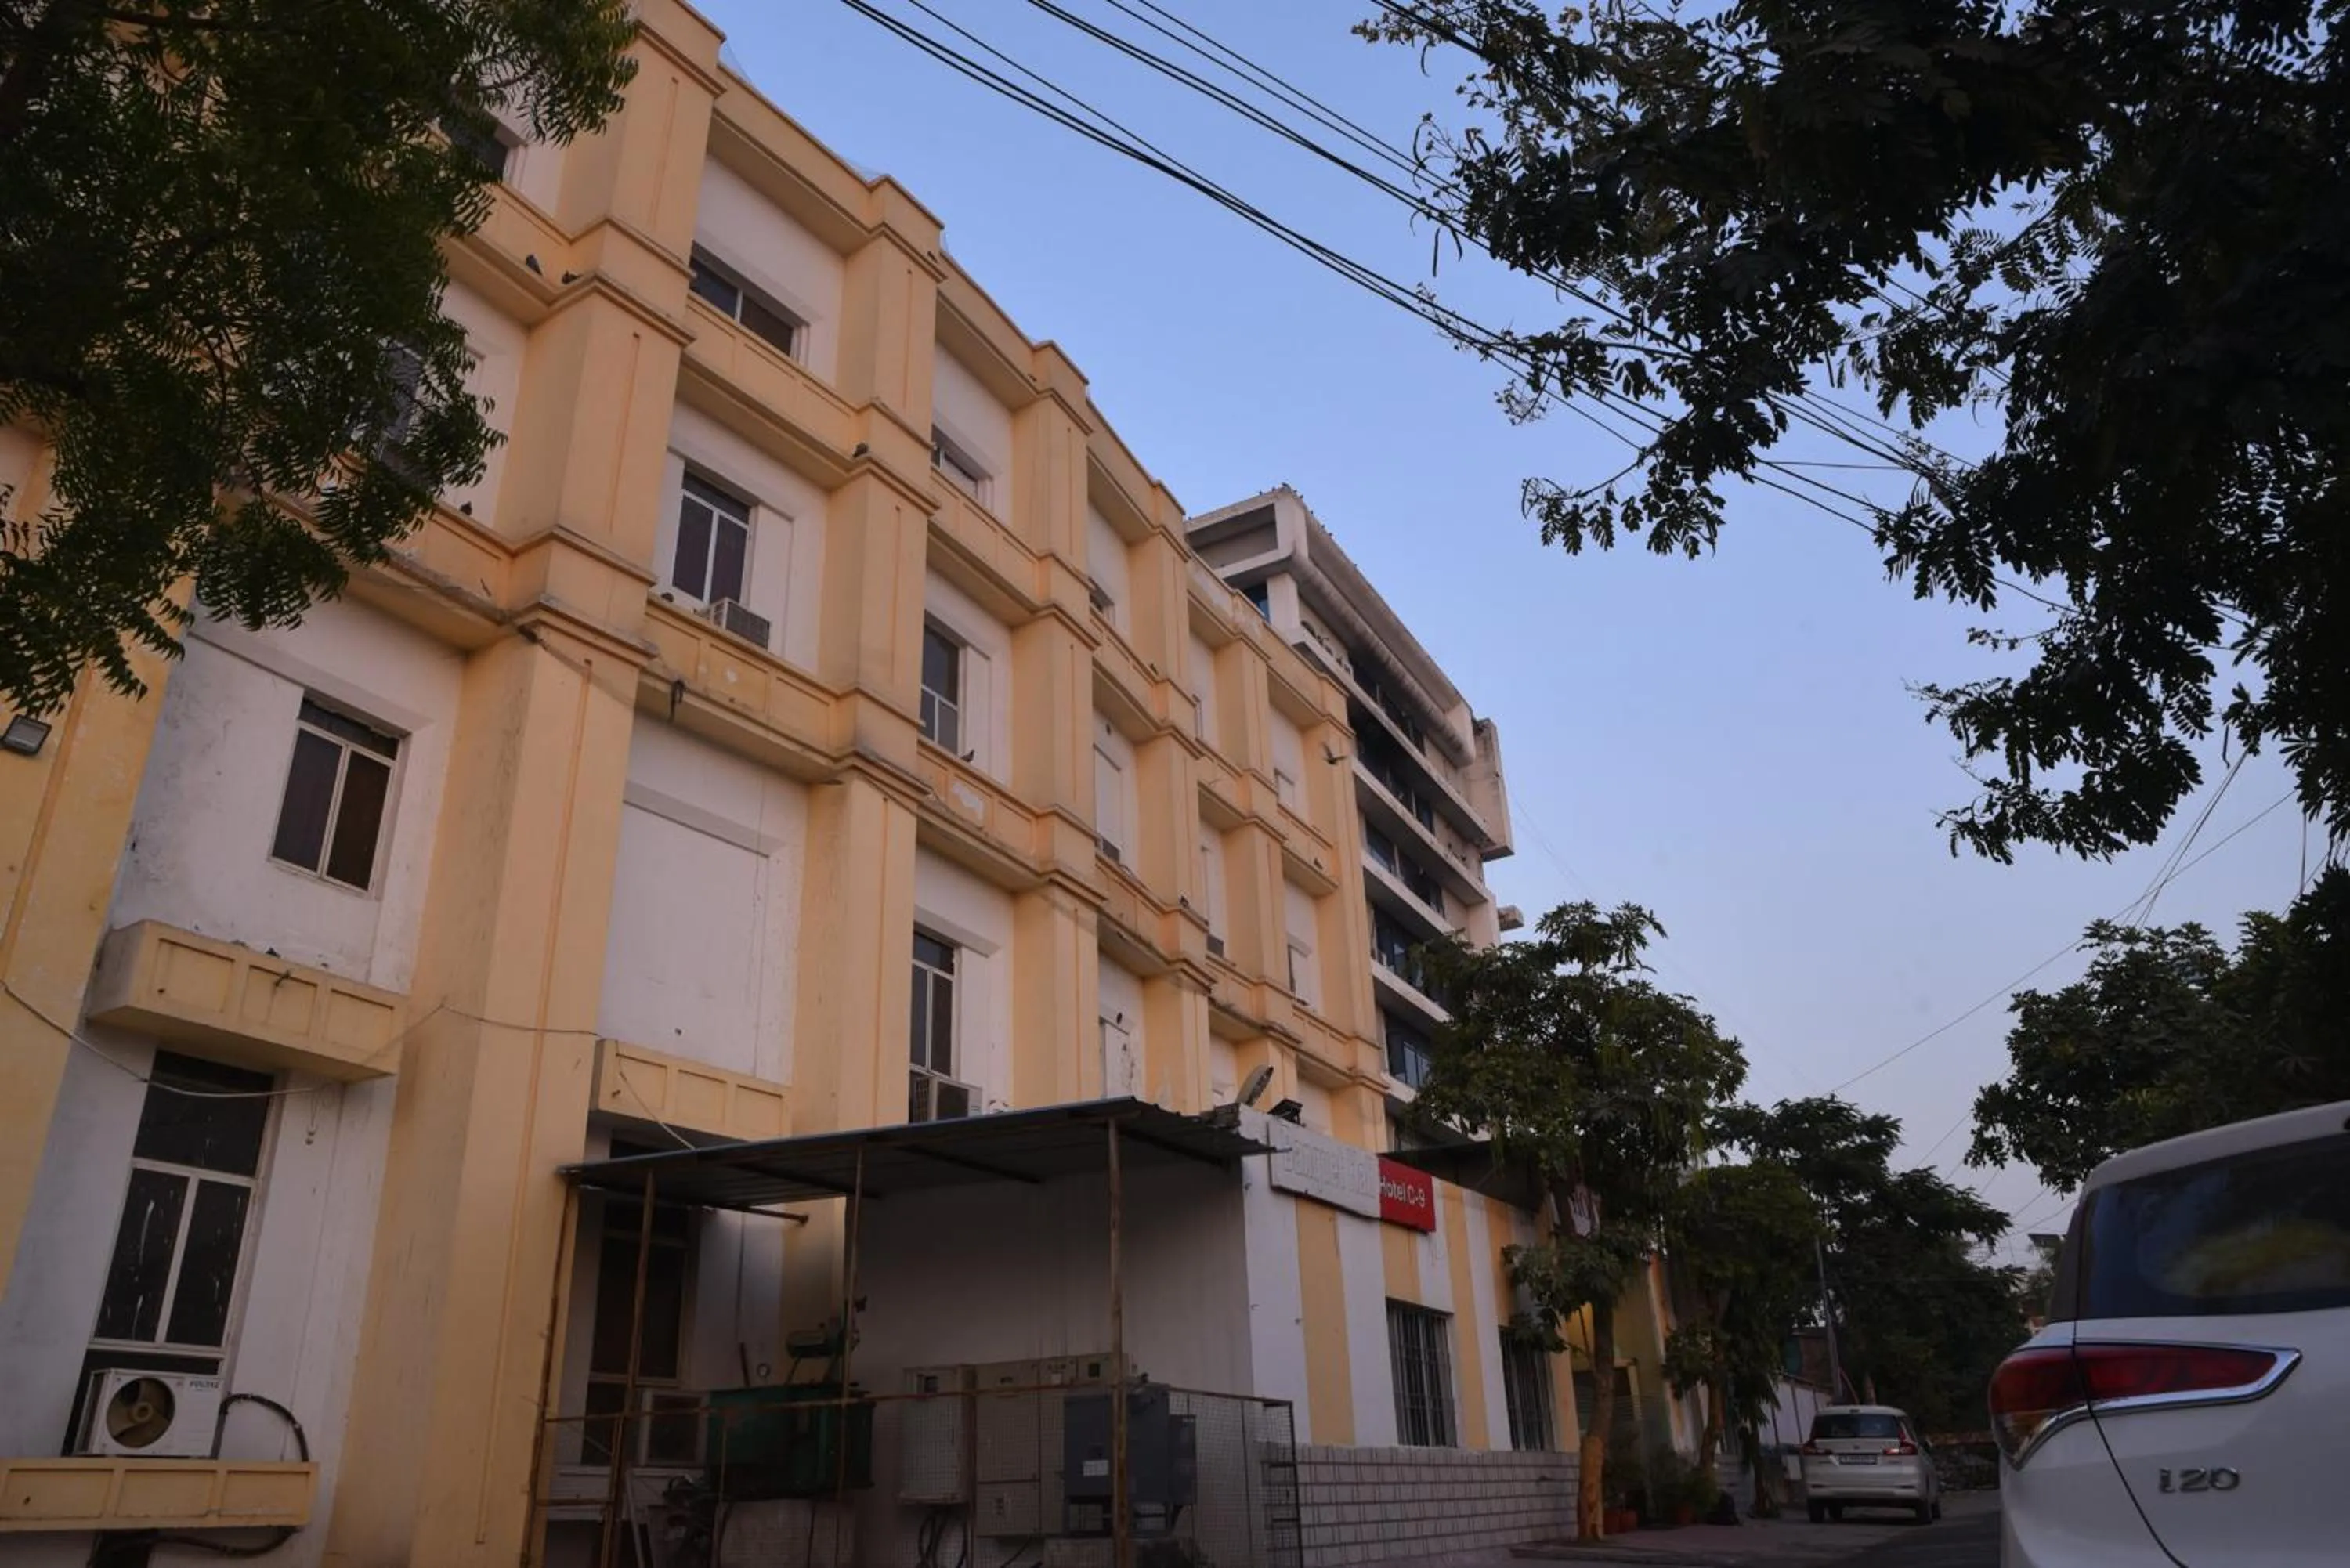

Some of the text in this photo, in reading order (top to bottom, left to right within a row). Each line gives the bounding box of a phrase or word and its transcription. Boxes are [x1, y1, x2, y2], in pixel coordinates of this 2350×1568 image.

[1379, 1175, 1425, 1208] Hotel C-9
[2159, 1467, 2240, 1493] i20
